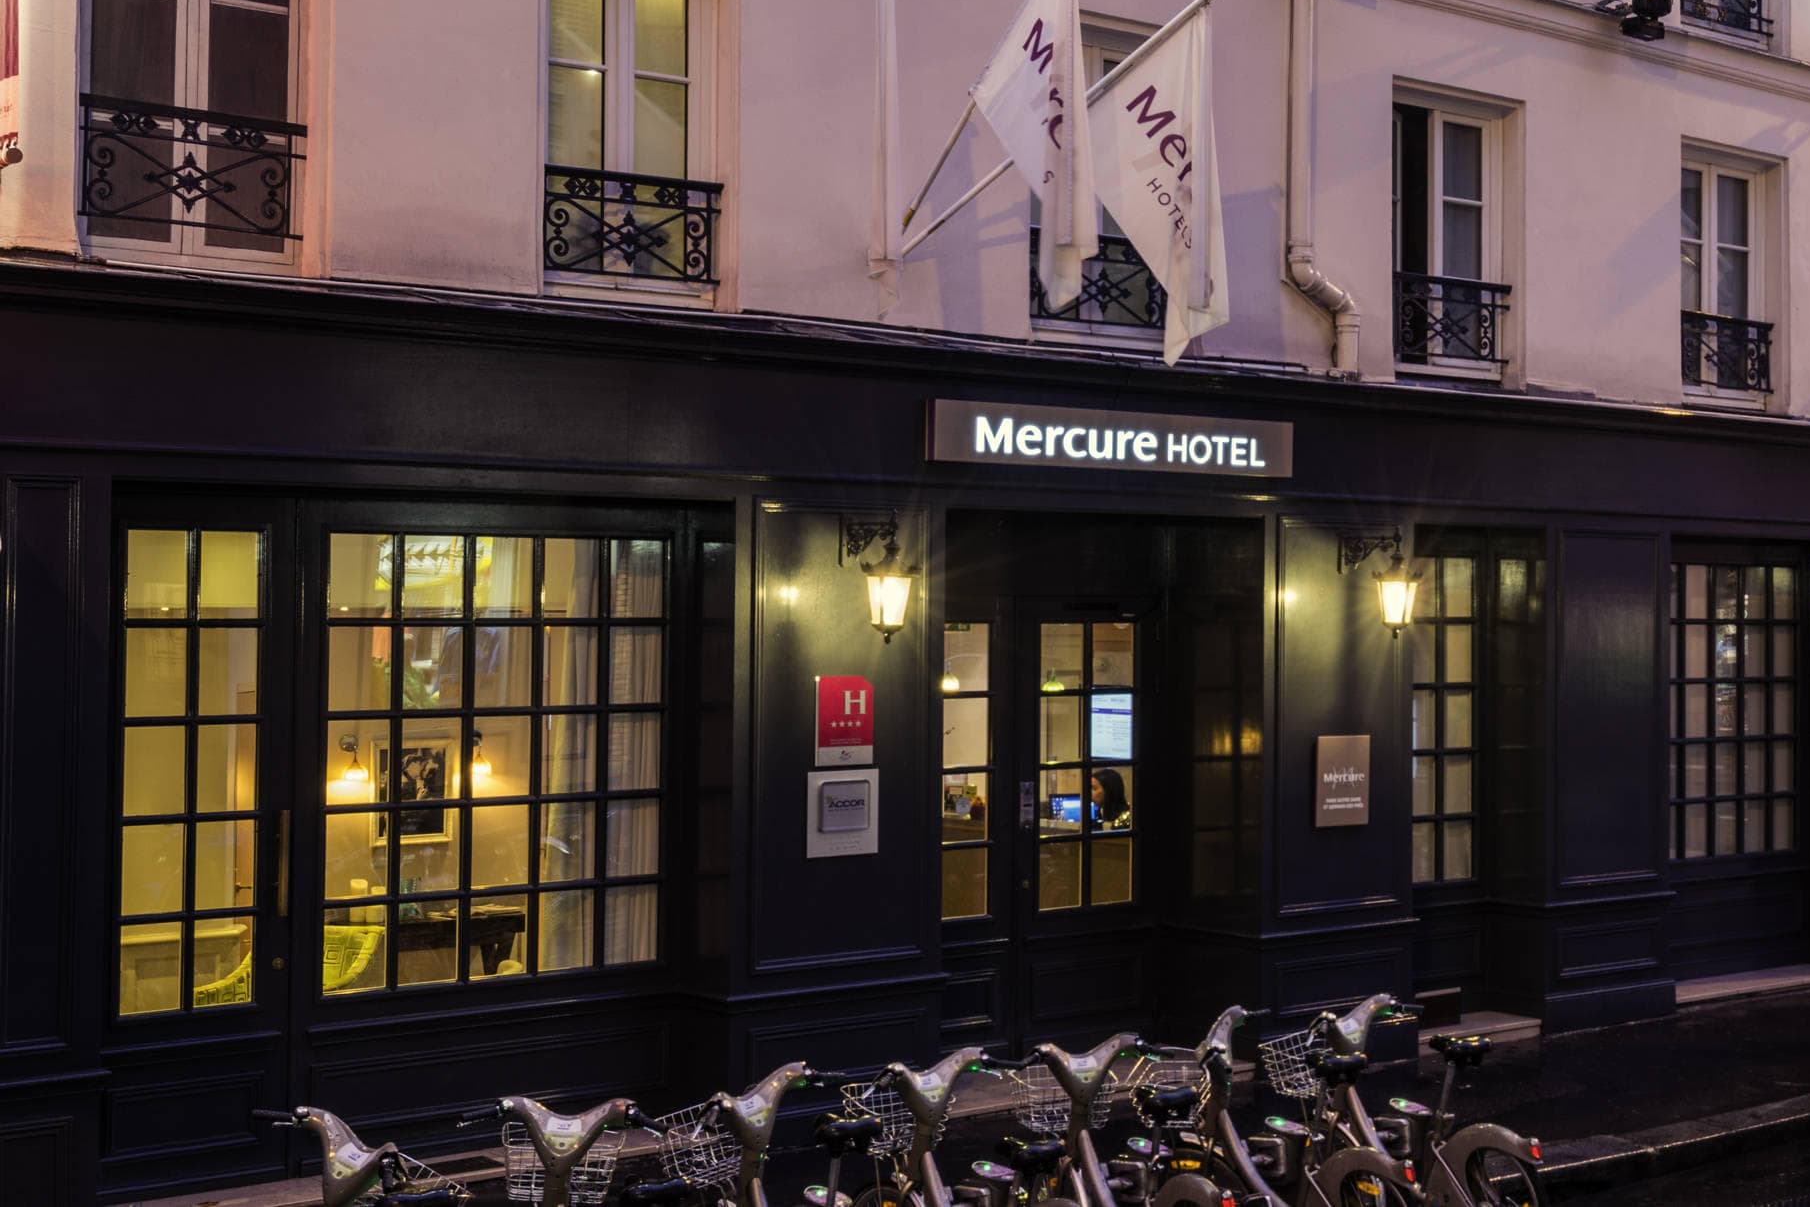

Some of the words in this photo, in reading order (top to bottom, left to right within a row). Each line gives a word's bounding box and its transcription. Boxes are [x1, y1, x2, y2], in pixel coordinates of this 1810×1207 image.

[975, 416, 1158, 462] Mercure
[1167, 433, 1266, 467] HOTEL
[843, 689, 867, 715] H
